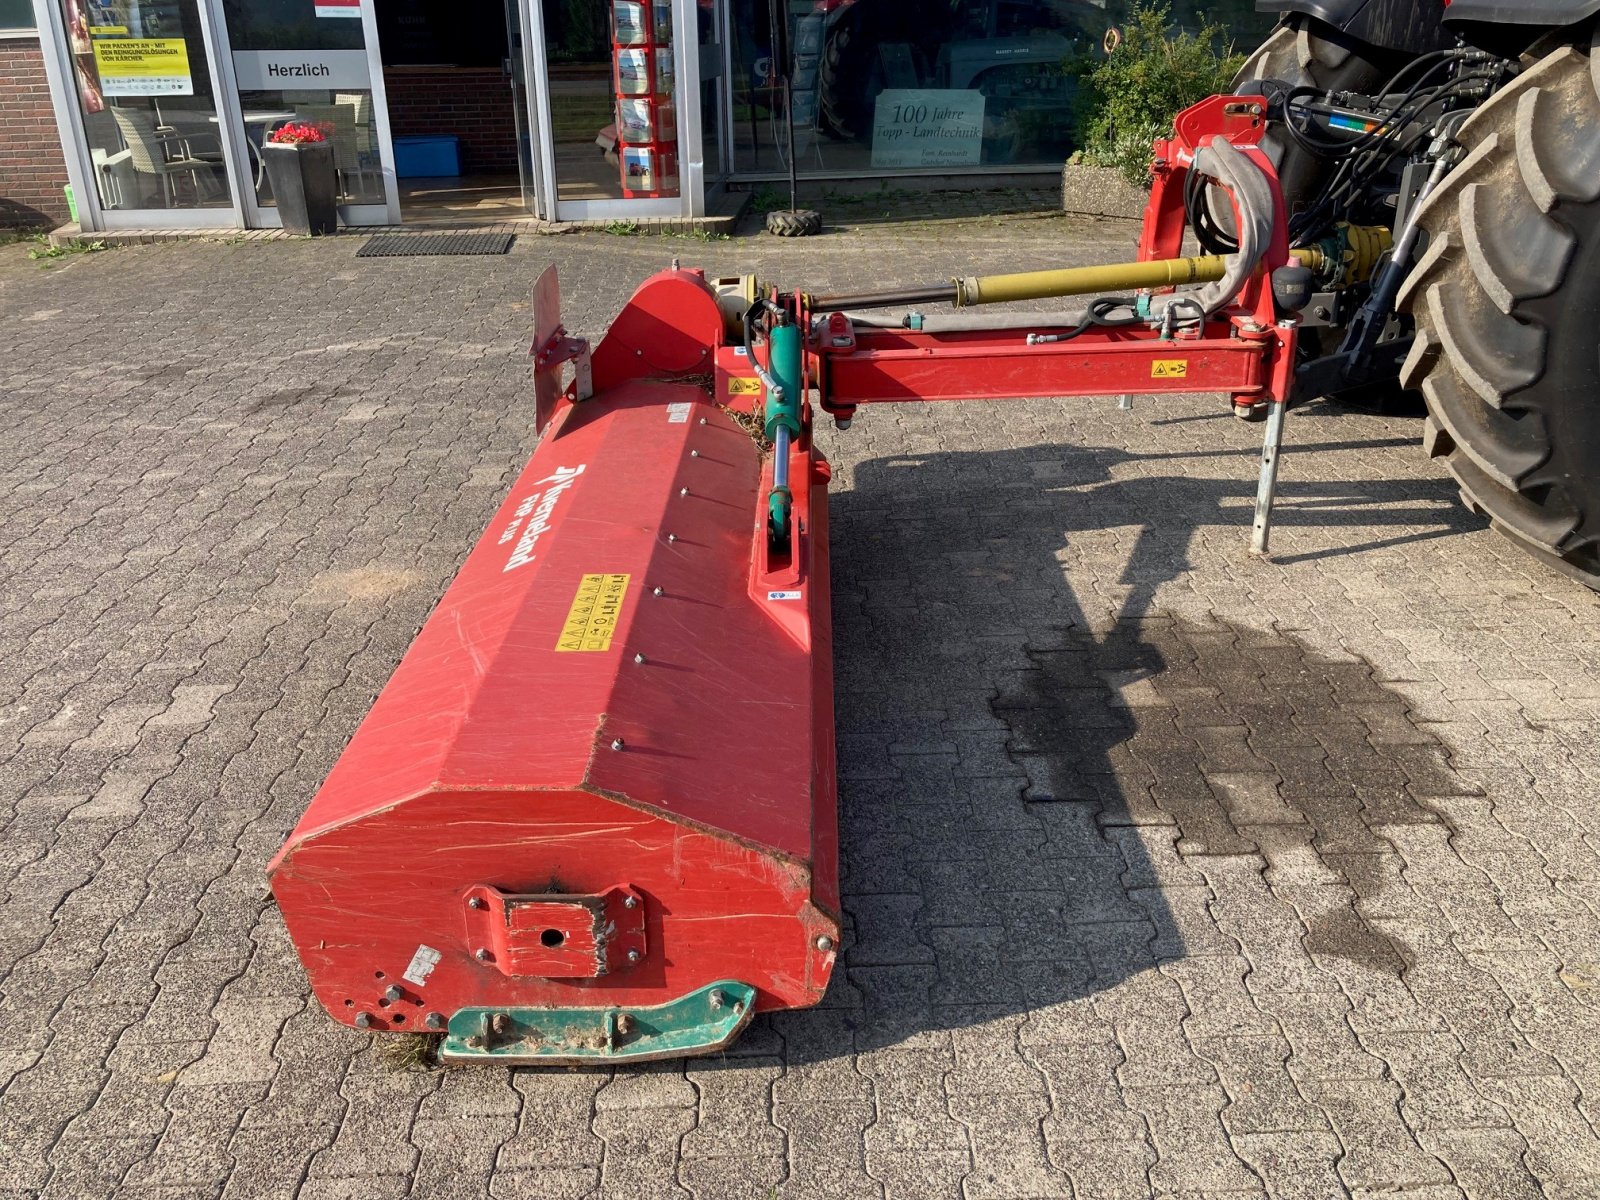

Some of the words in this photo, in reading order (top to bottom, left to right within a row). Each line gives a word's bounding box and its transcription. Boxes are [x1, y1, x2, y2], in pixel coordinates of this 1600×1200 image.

[268, 63, 330, 76] Herzlich
[893, 104, 928, 124] 100
[931, 106, 964, 122] Jahre
[875, 125, 903, 140] Topp
[913, 125, 980, 138] Landtechnik
[514, 492, 541, 517] FHP
[498, 518, 523, 545] PLUS
[502, 478, 575, 573] Kverneland
